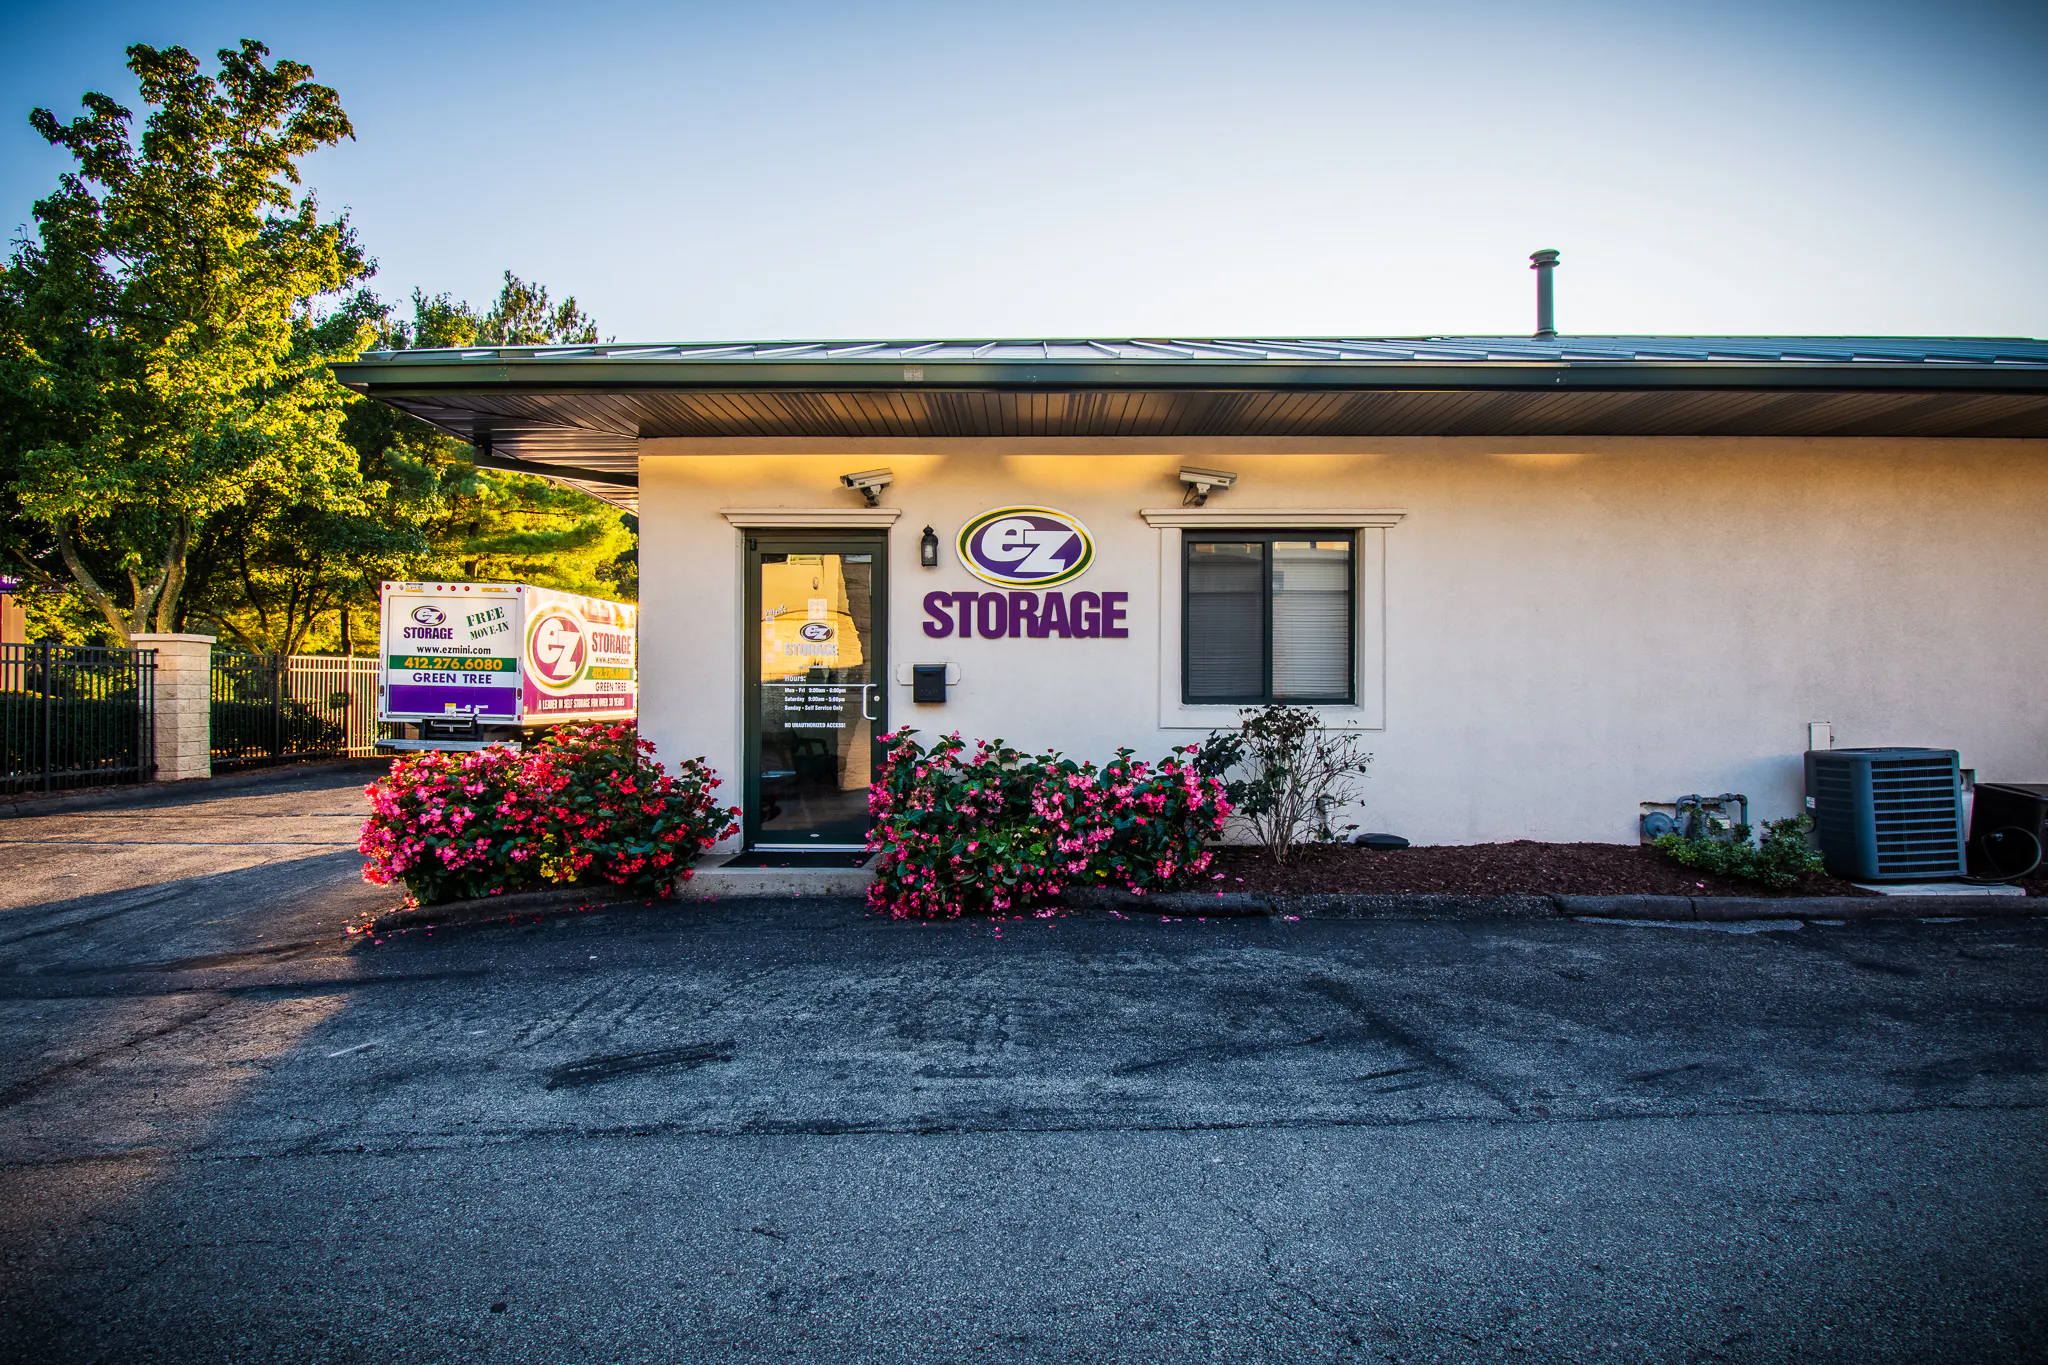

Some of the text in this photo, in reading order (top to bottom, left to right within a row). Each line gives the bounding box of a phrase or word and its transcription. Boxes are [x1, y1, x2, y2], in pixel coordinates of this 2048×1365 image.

[466, 606, 505, 627] FREE
[922, 591, 1129, 639] STORAGE
[403, 627, 454, 640] STORAGE
[469, 621, 510, 641] MOVE-IN
[591, 631, 632, 655] STORAGE
[416, 645, 491, 655] www.ezmini.com
[784, 644, 837, 656] STORAGE
[404, 657, 503, 671] 412.276.6080
[413, 672, 492, 685] GREEN TREE
[595, 682, 627, 691] GREEN TREE
